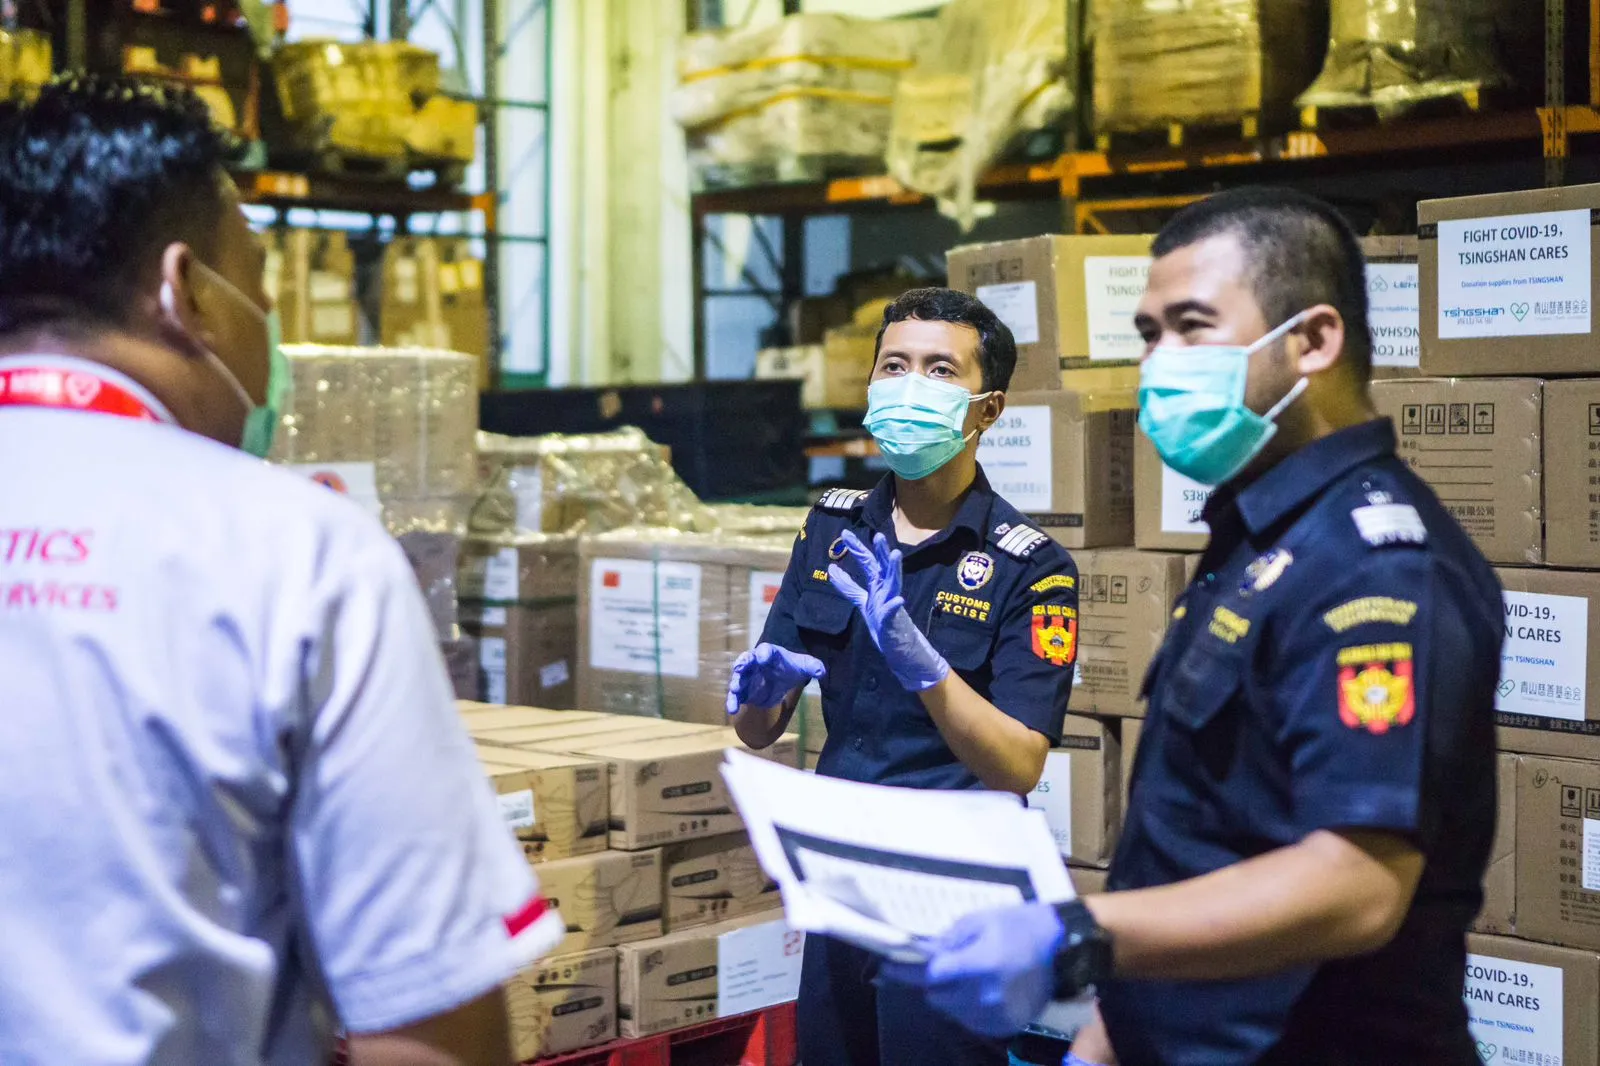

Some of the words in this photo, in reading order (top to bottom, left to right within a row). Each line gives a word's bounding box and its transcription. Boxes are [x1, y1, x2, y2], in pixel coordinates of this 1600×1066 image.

[1463, 227, 1497, 244] FIGHT
[1500, 224, 1563, 241] COVID-19,
[1458, 248, 1526, 265] TSINGSHAN
[1529, 245, 1569, 261] CARES
[1109, 265, 1138, 278] FIGHT
[1461, 280, 1488, 288] Donation
[1488, 279, 1512, 288] supplies
[1513, 278, 1528, 286] from
[1528, 275, 1564, 285] TSINGSHAN
[997, 435, 1032, 448] CARES
[937, 591, 991, 612] CUSTOMS
[938, 601, 988, 622] XCISE
[1517, 627, 1561, 643] CARES
[1515, 655, 1555, 667] TSINGSHAN
[1465, 964, 1535, 989] COVID-19,
[1497, 992, 1541, 1011] CARES
[1479, 1016, 1496, 1027] from
[1496, 1020, 1535, 1034] TSINGSHAN
